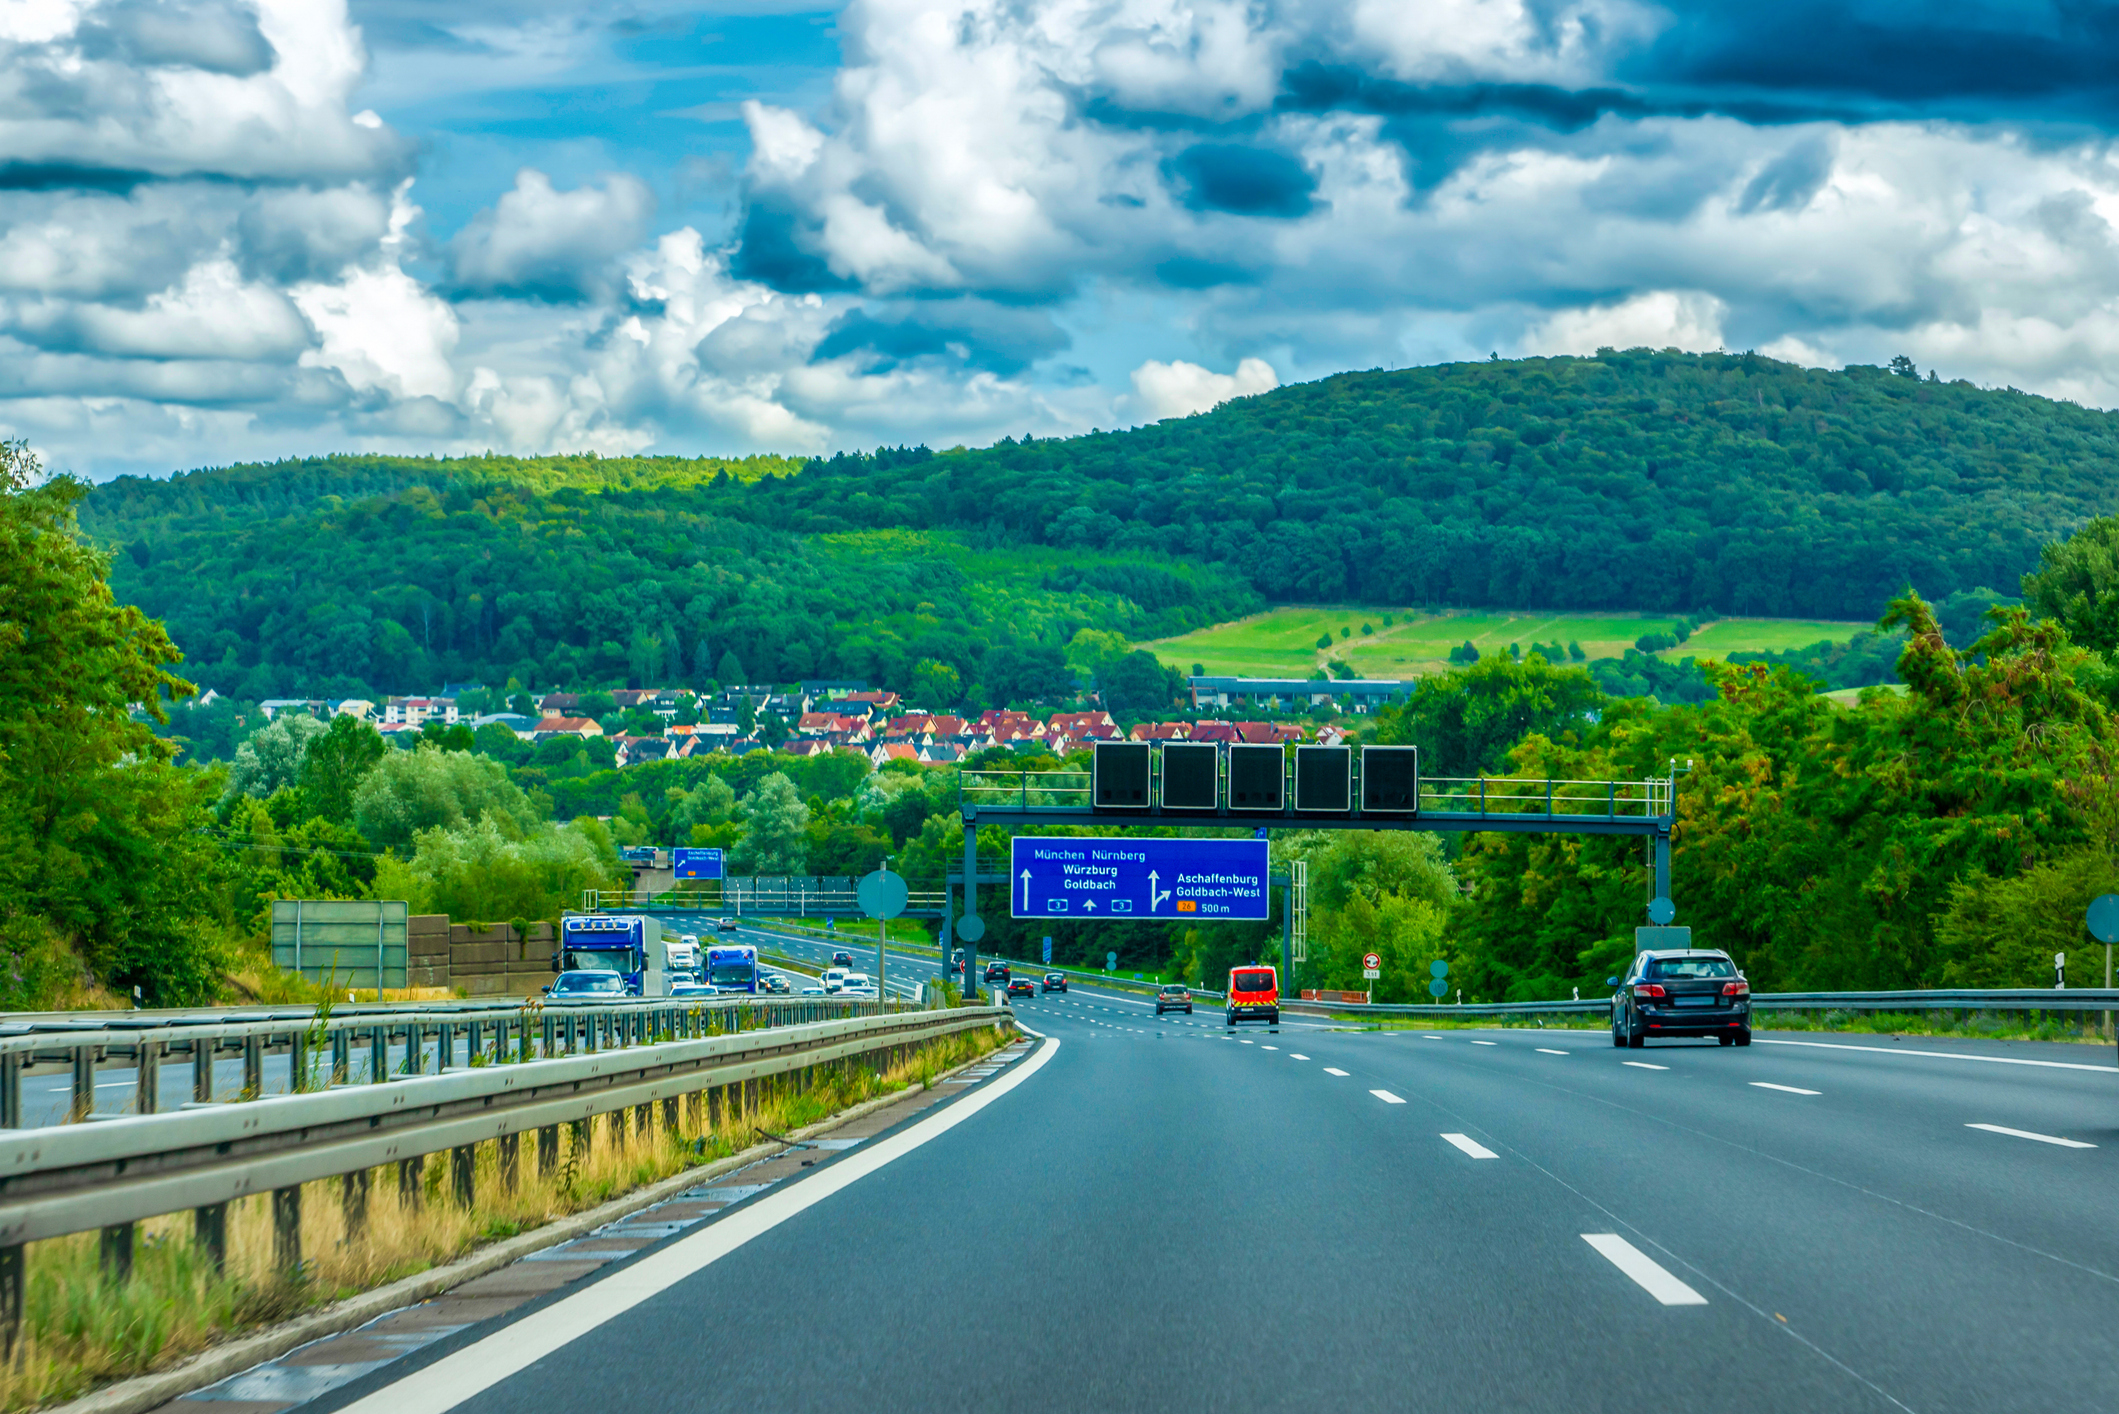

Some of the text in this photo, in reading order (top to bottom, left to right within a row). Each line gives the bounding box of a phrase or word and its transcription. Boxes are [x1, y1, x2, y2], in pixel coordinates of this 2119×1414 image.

[1034, 849, 1146, 863] München Nürnberg
[1063, 864, 1118, 878] Würzburg
[1064, 879, 1116, 890] Goldbach
[1177, 873, 1258, 887] Aschaffenburg
[1176, 886, 1260, 898] Goldbach-West
[1182, 902, 1192, 910] 26
[1201, 904, 1219, 913] 500
